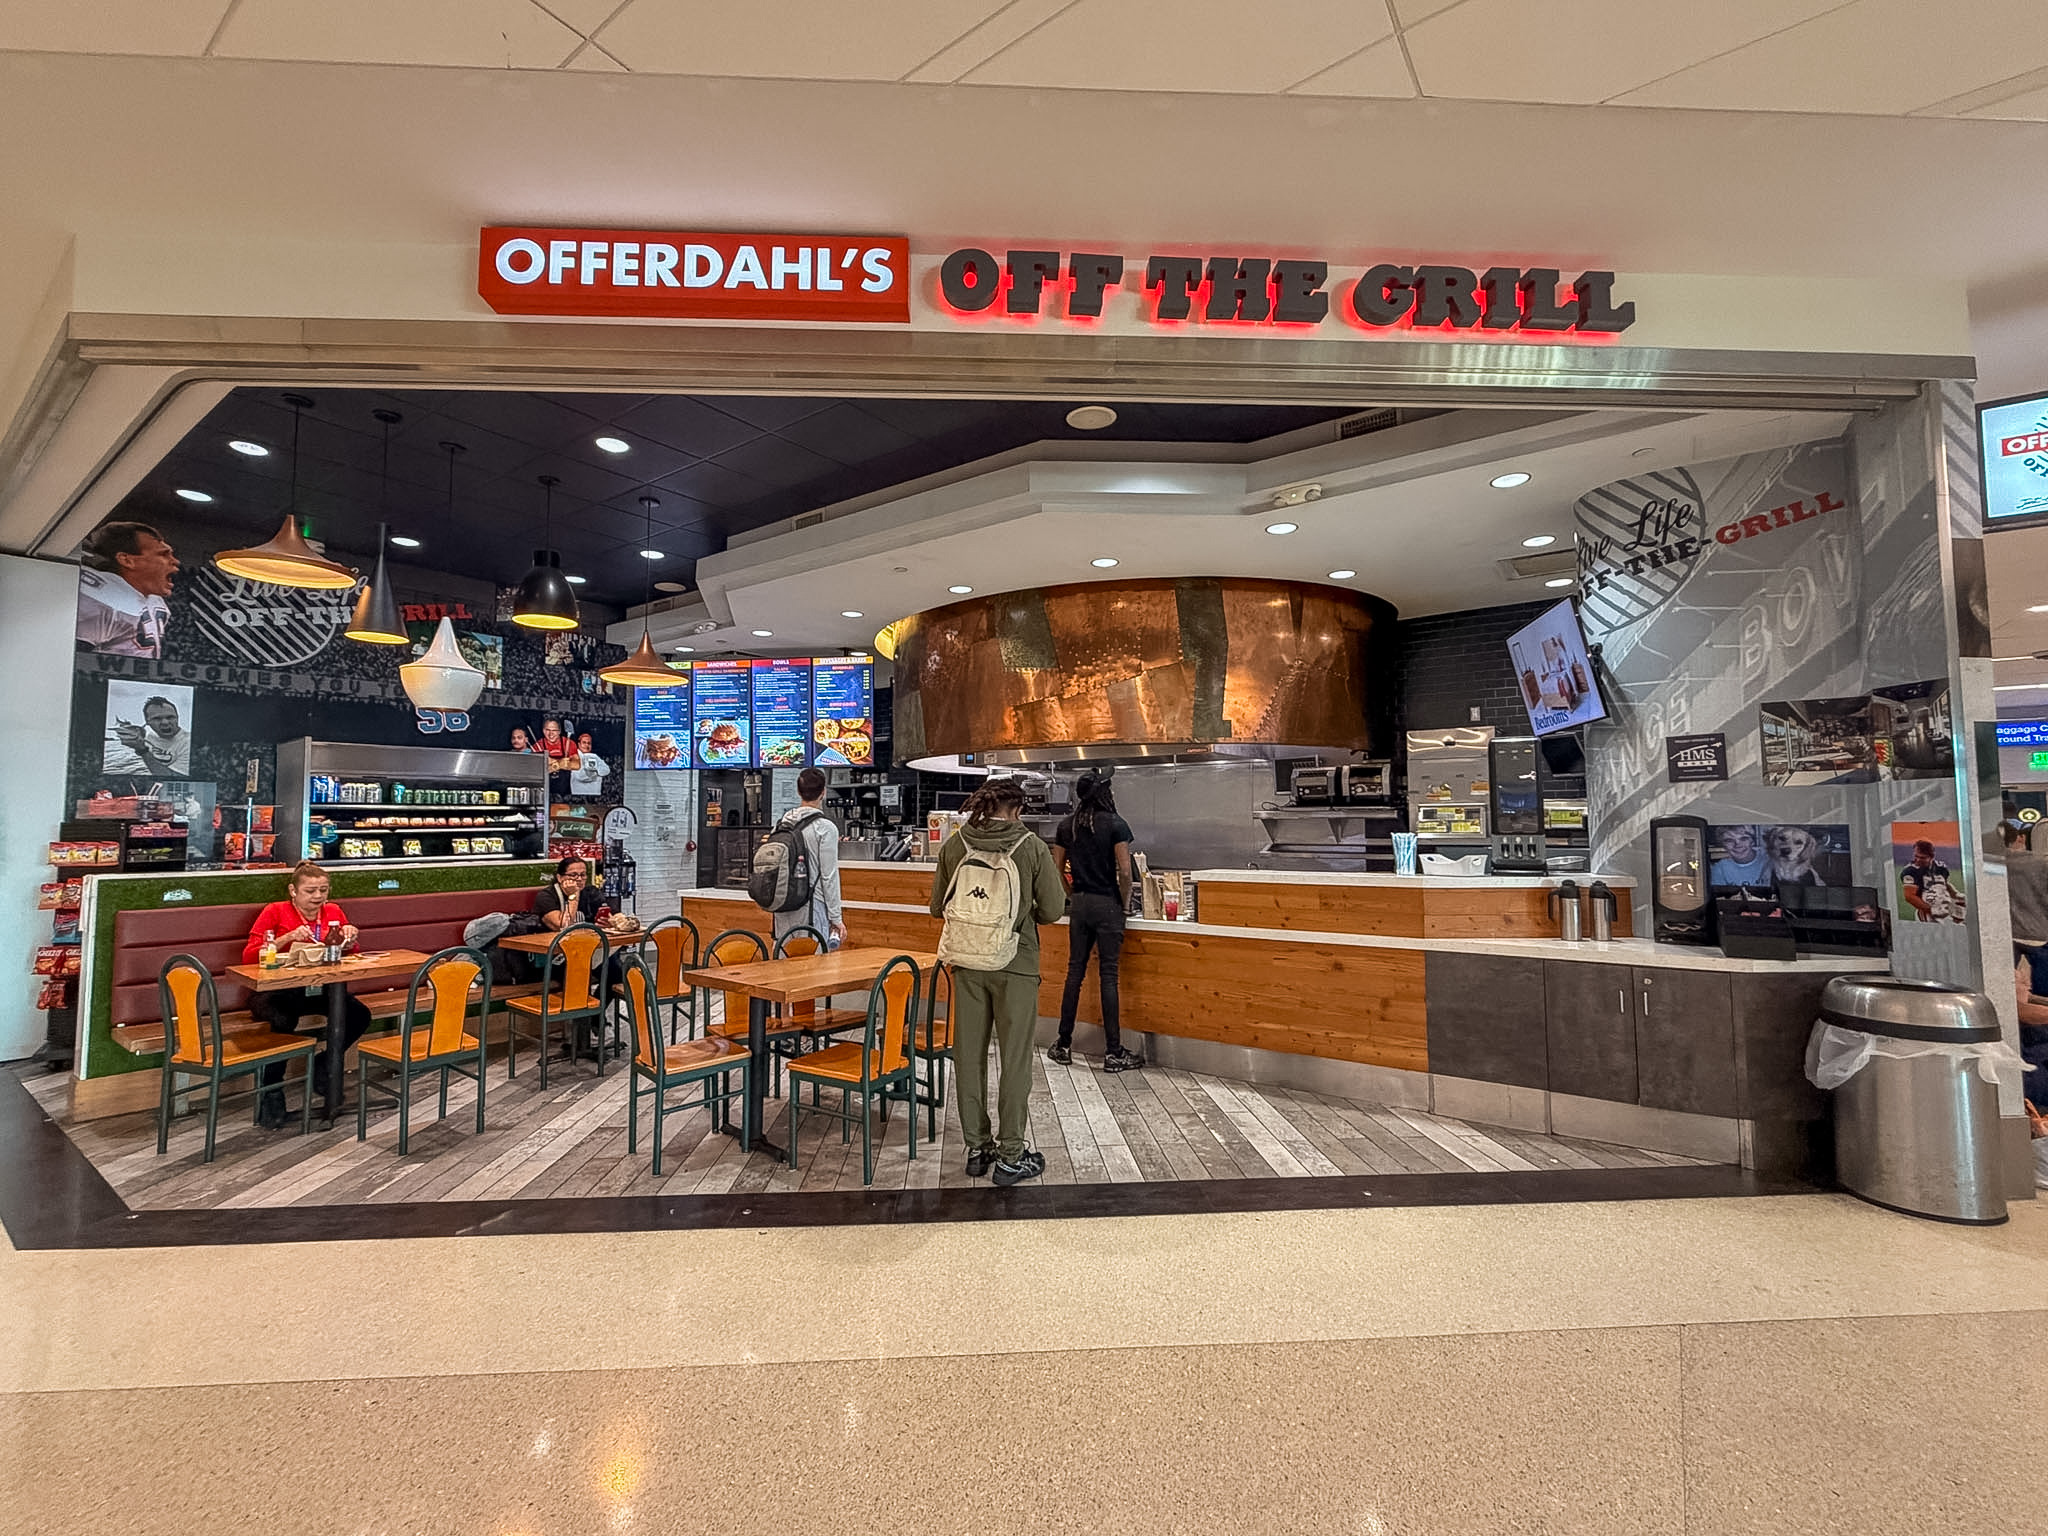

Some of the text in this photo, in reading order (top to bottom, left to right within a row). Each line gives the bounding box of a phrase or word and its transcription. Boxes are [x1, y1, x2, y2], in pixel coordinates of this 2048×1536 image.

[495, 237, 894, 293] OFFERDAHL'S
[940, 248, 1636, 333] OFF THE GRILL
[1623, 498, 1695, 552] Life
[96, 655, 292, 687] WELCOMES
[311, 674, 360, 693] YOU
[1535, 711, 1569, 730] Bedrooms
[1998, 735, 2031, 743] round
[1680, 749, 1716, 761] HMS
